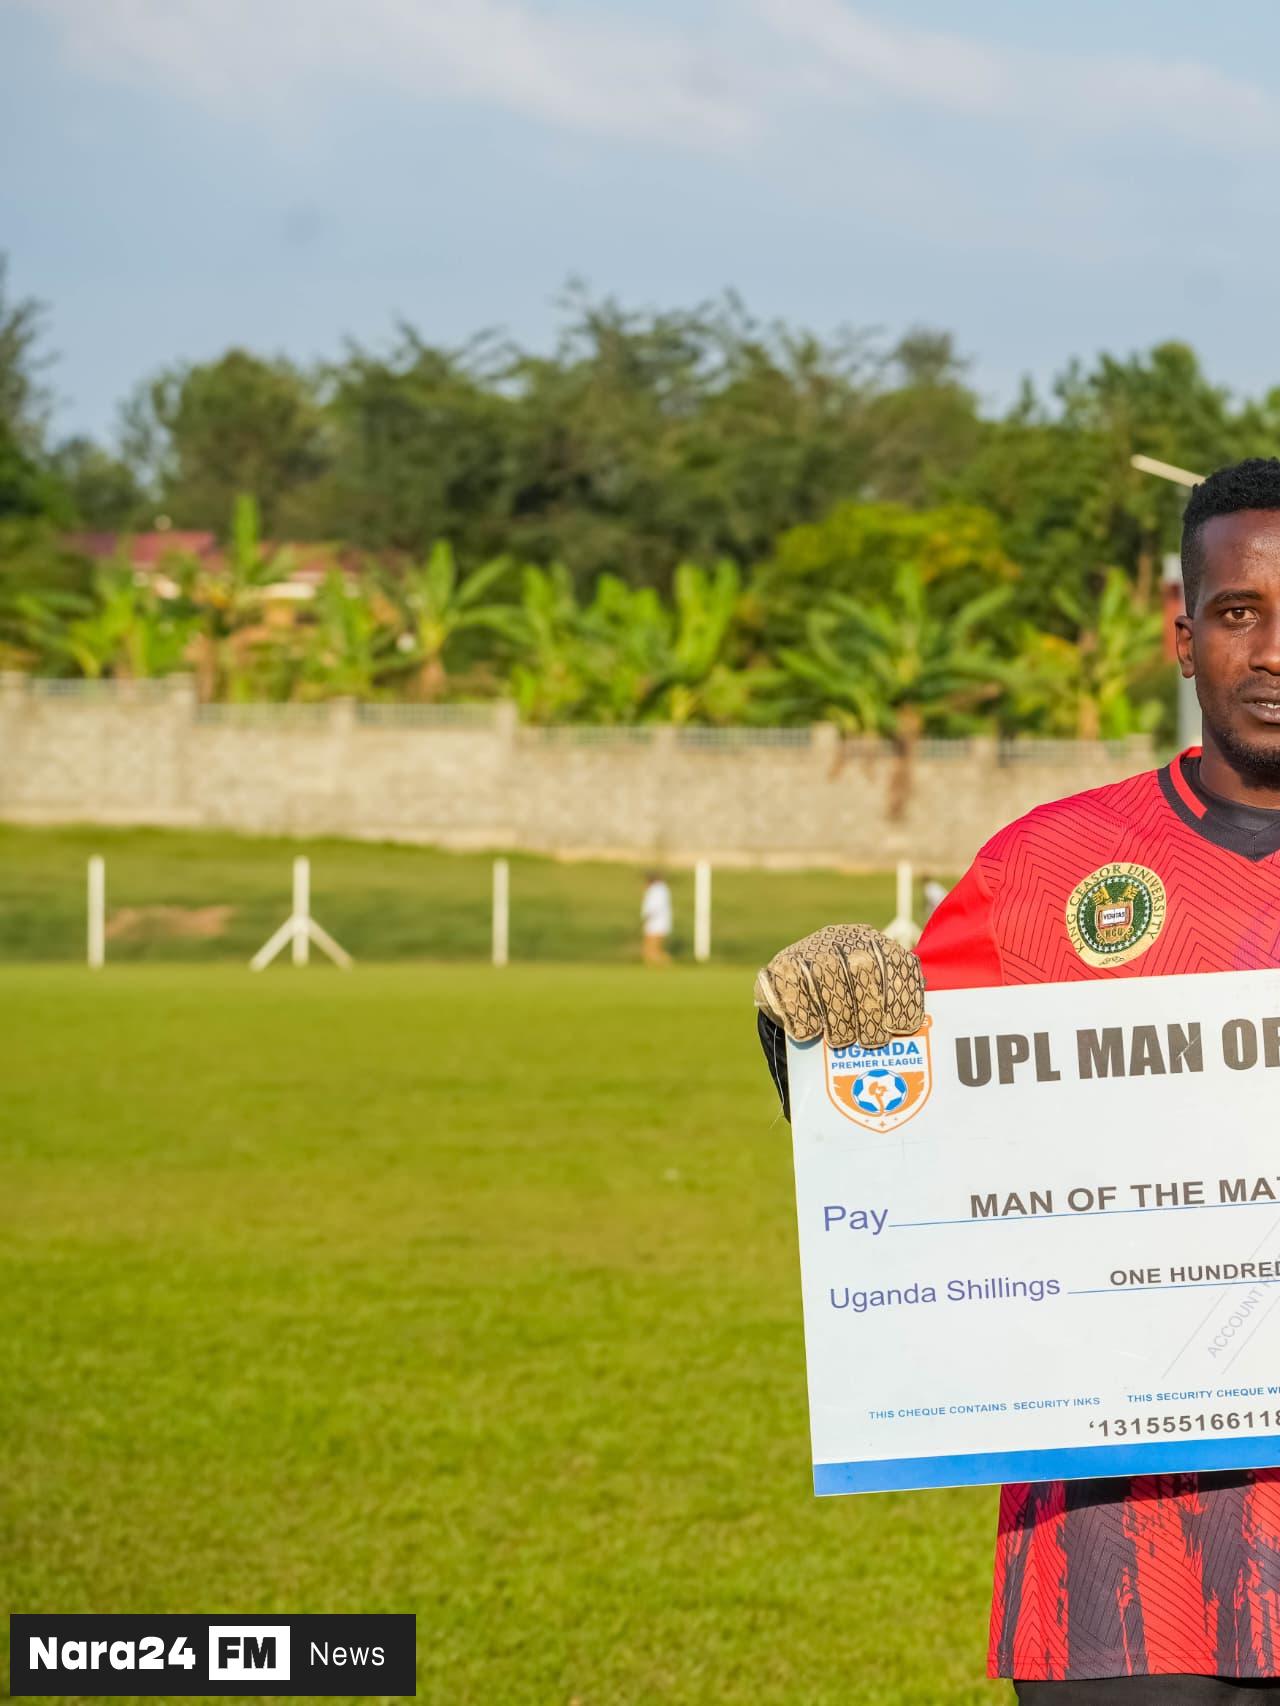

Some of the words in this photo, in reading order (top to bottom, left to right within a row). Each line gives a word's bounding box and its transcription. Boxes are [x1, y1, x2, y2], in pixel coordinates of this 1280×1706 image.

[1070, 865, 1121, 907] CEASOR
[1127, 866, 1164, 939] UNIVERSITY
[1067, 914, 1085, 953] KING
[831, 1059, 879, 1070] PREMIER
[882, 1057, 923, 1067] LEAGUE
[833, 1041, 920, 1059] UGANDA
[955, 1031, 1061, 1087] UPL
[1077, 1022, 1204, 1080] MAN
[823, 1205, 889, 1236] Pay
[970, 1190, 1053, 1218] MAN
[1067, 1186, 1117, 1212] OF
[1130, 1181, 1206, 1208] THE
[829, 1282, 937, 1313] Uganda
[946, 1276, 1061, 1301] Shillings
[1109, 1268, 1162, 1286] ONE
[1207, 1289, 1264, 1358] ACCOUNT
[869, 1410, 895, 1420] THIS
[898, 1407, 946, 1418] CHEQUE
[950, 1403, 1007, 1414] CONTAINS
[1013, 1399, 1070, 1410] SECURITY
[1073, 1397, 1100, 1407] INKS
[1127, 1394, 1153, 1403] THIS
[1156, 1390, 1213, 1401] SECURITY
[1216, 1387, 1264, 1398] CHEQUE
